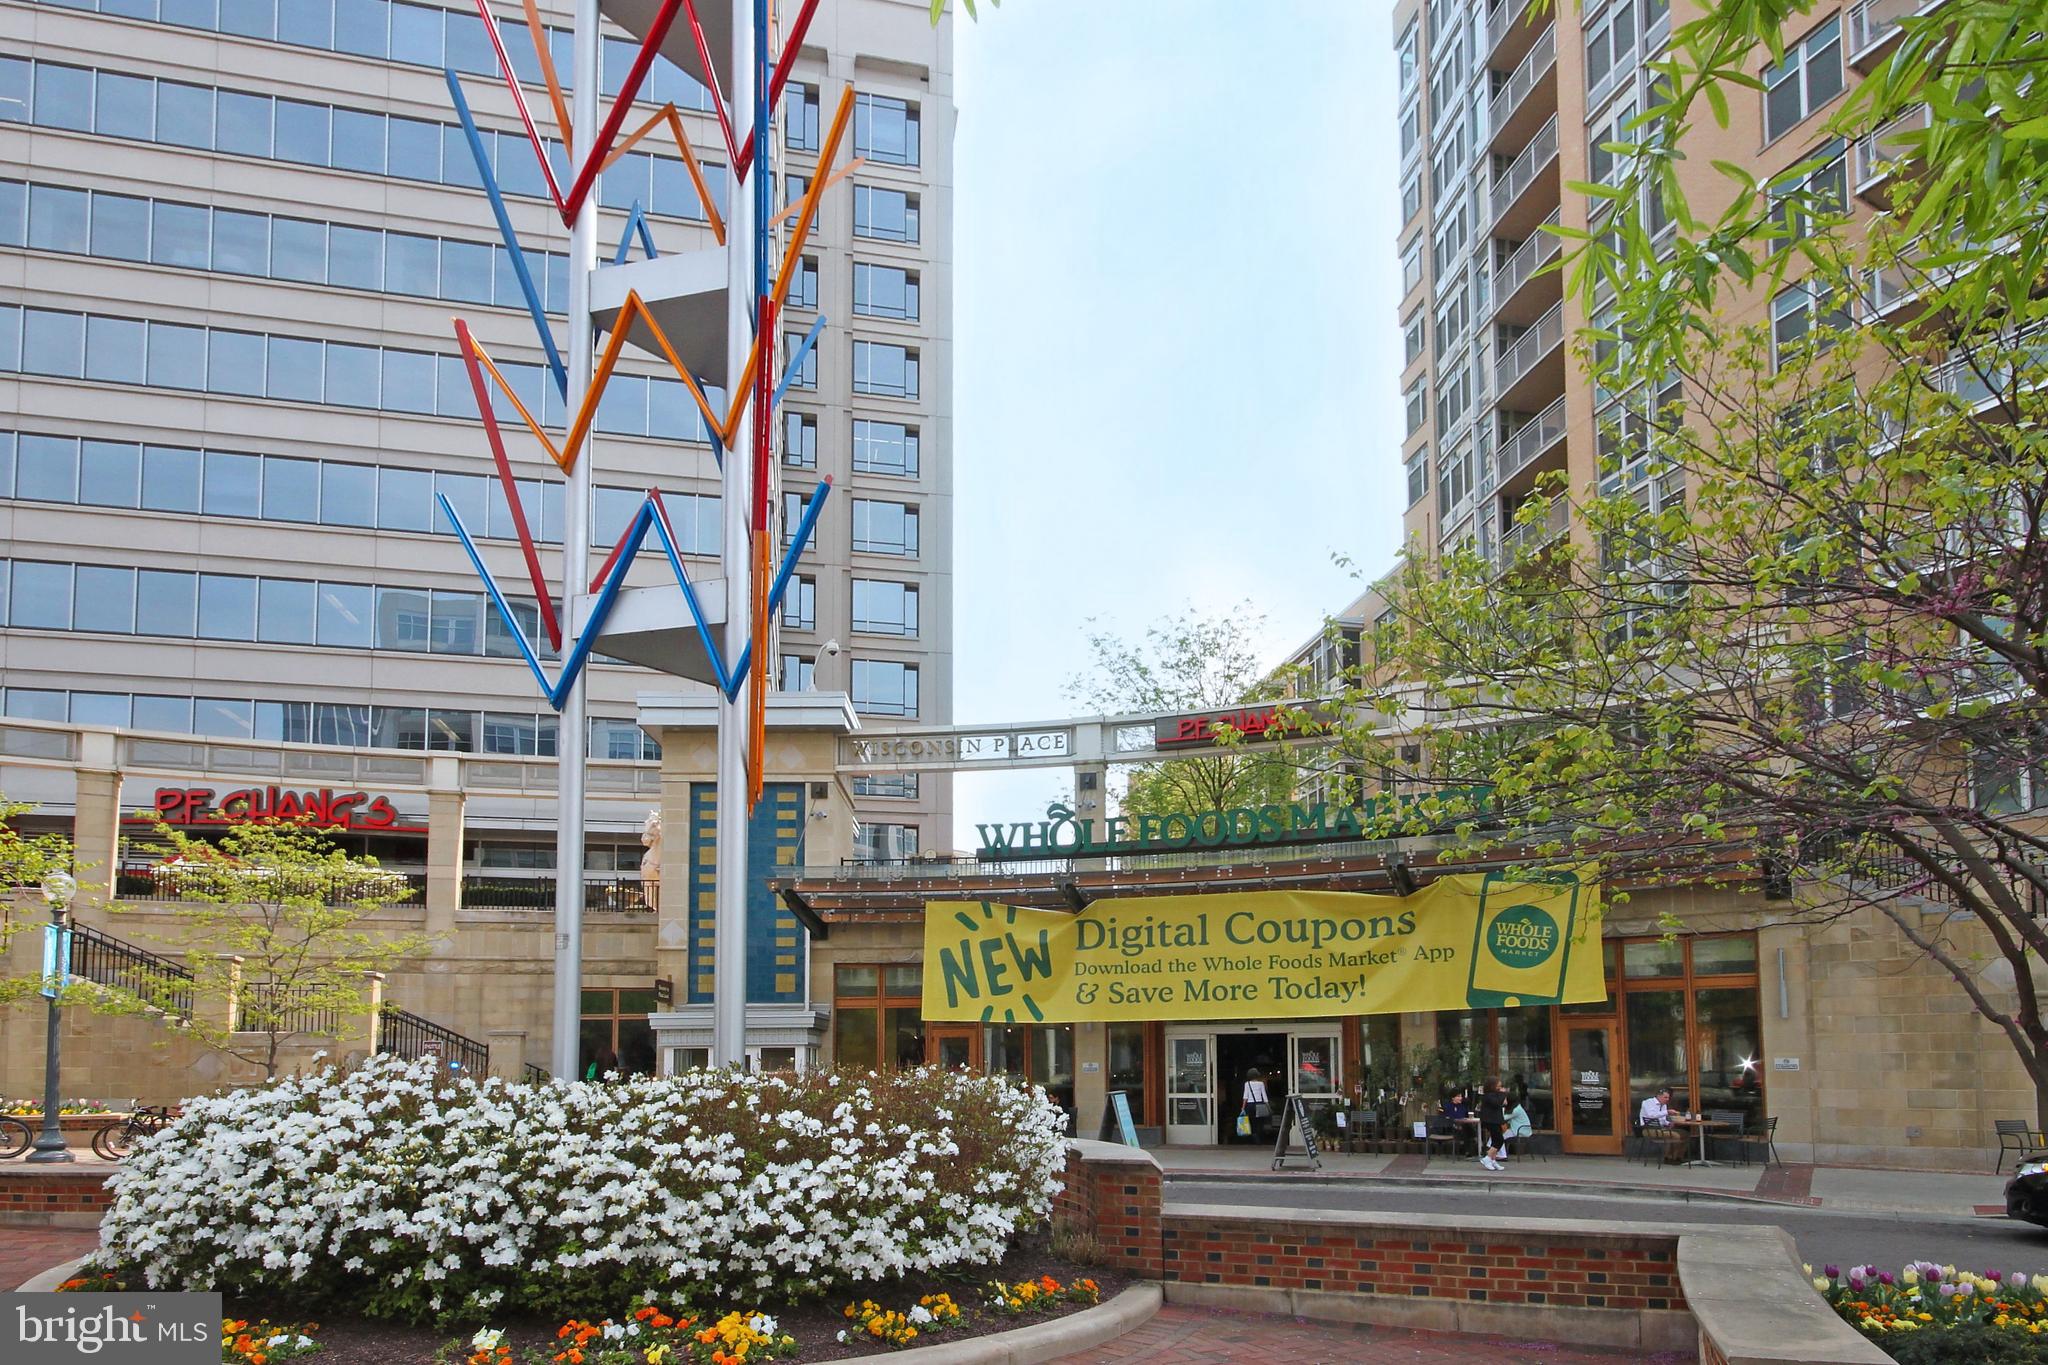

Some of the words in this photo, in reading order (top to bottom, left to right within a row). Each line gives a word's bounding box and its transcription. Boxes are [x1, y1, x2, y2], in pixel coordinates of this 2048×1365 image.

[851, 738, 982, 759] WISCONSIN
[993, 734, 1066, 753] PLACE
[975, 804, 1132, 853] WHOLE
[1137, 804, 1283, 849] FOODS
[1075, 913, 1210, 957] Digital
[1224, 910, 1417, 950] Coupons
[1495, 918, 1553, 939] WHOLE
[1495, 935, 1550, 951] FOODS
[939, 928, 1053, 1009] NEW
[1074, 959, 1162, 977] Download
[1168, 959, 1197, 973] the
[1203, 956, 1262, 972] Whole
[1268, 954, 1323, 970] Foods
[1413, 945, 1455, 963] App
[1500, 949, 1540, 957] MARKET
[1075, 982, 1100, 1005] &
[1108, 981, 1174, 1004] Save
[1183, 979, 1259, 1002] More
[1268, 973, 1367, 1004] Today!
